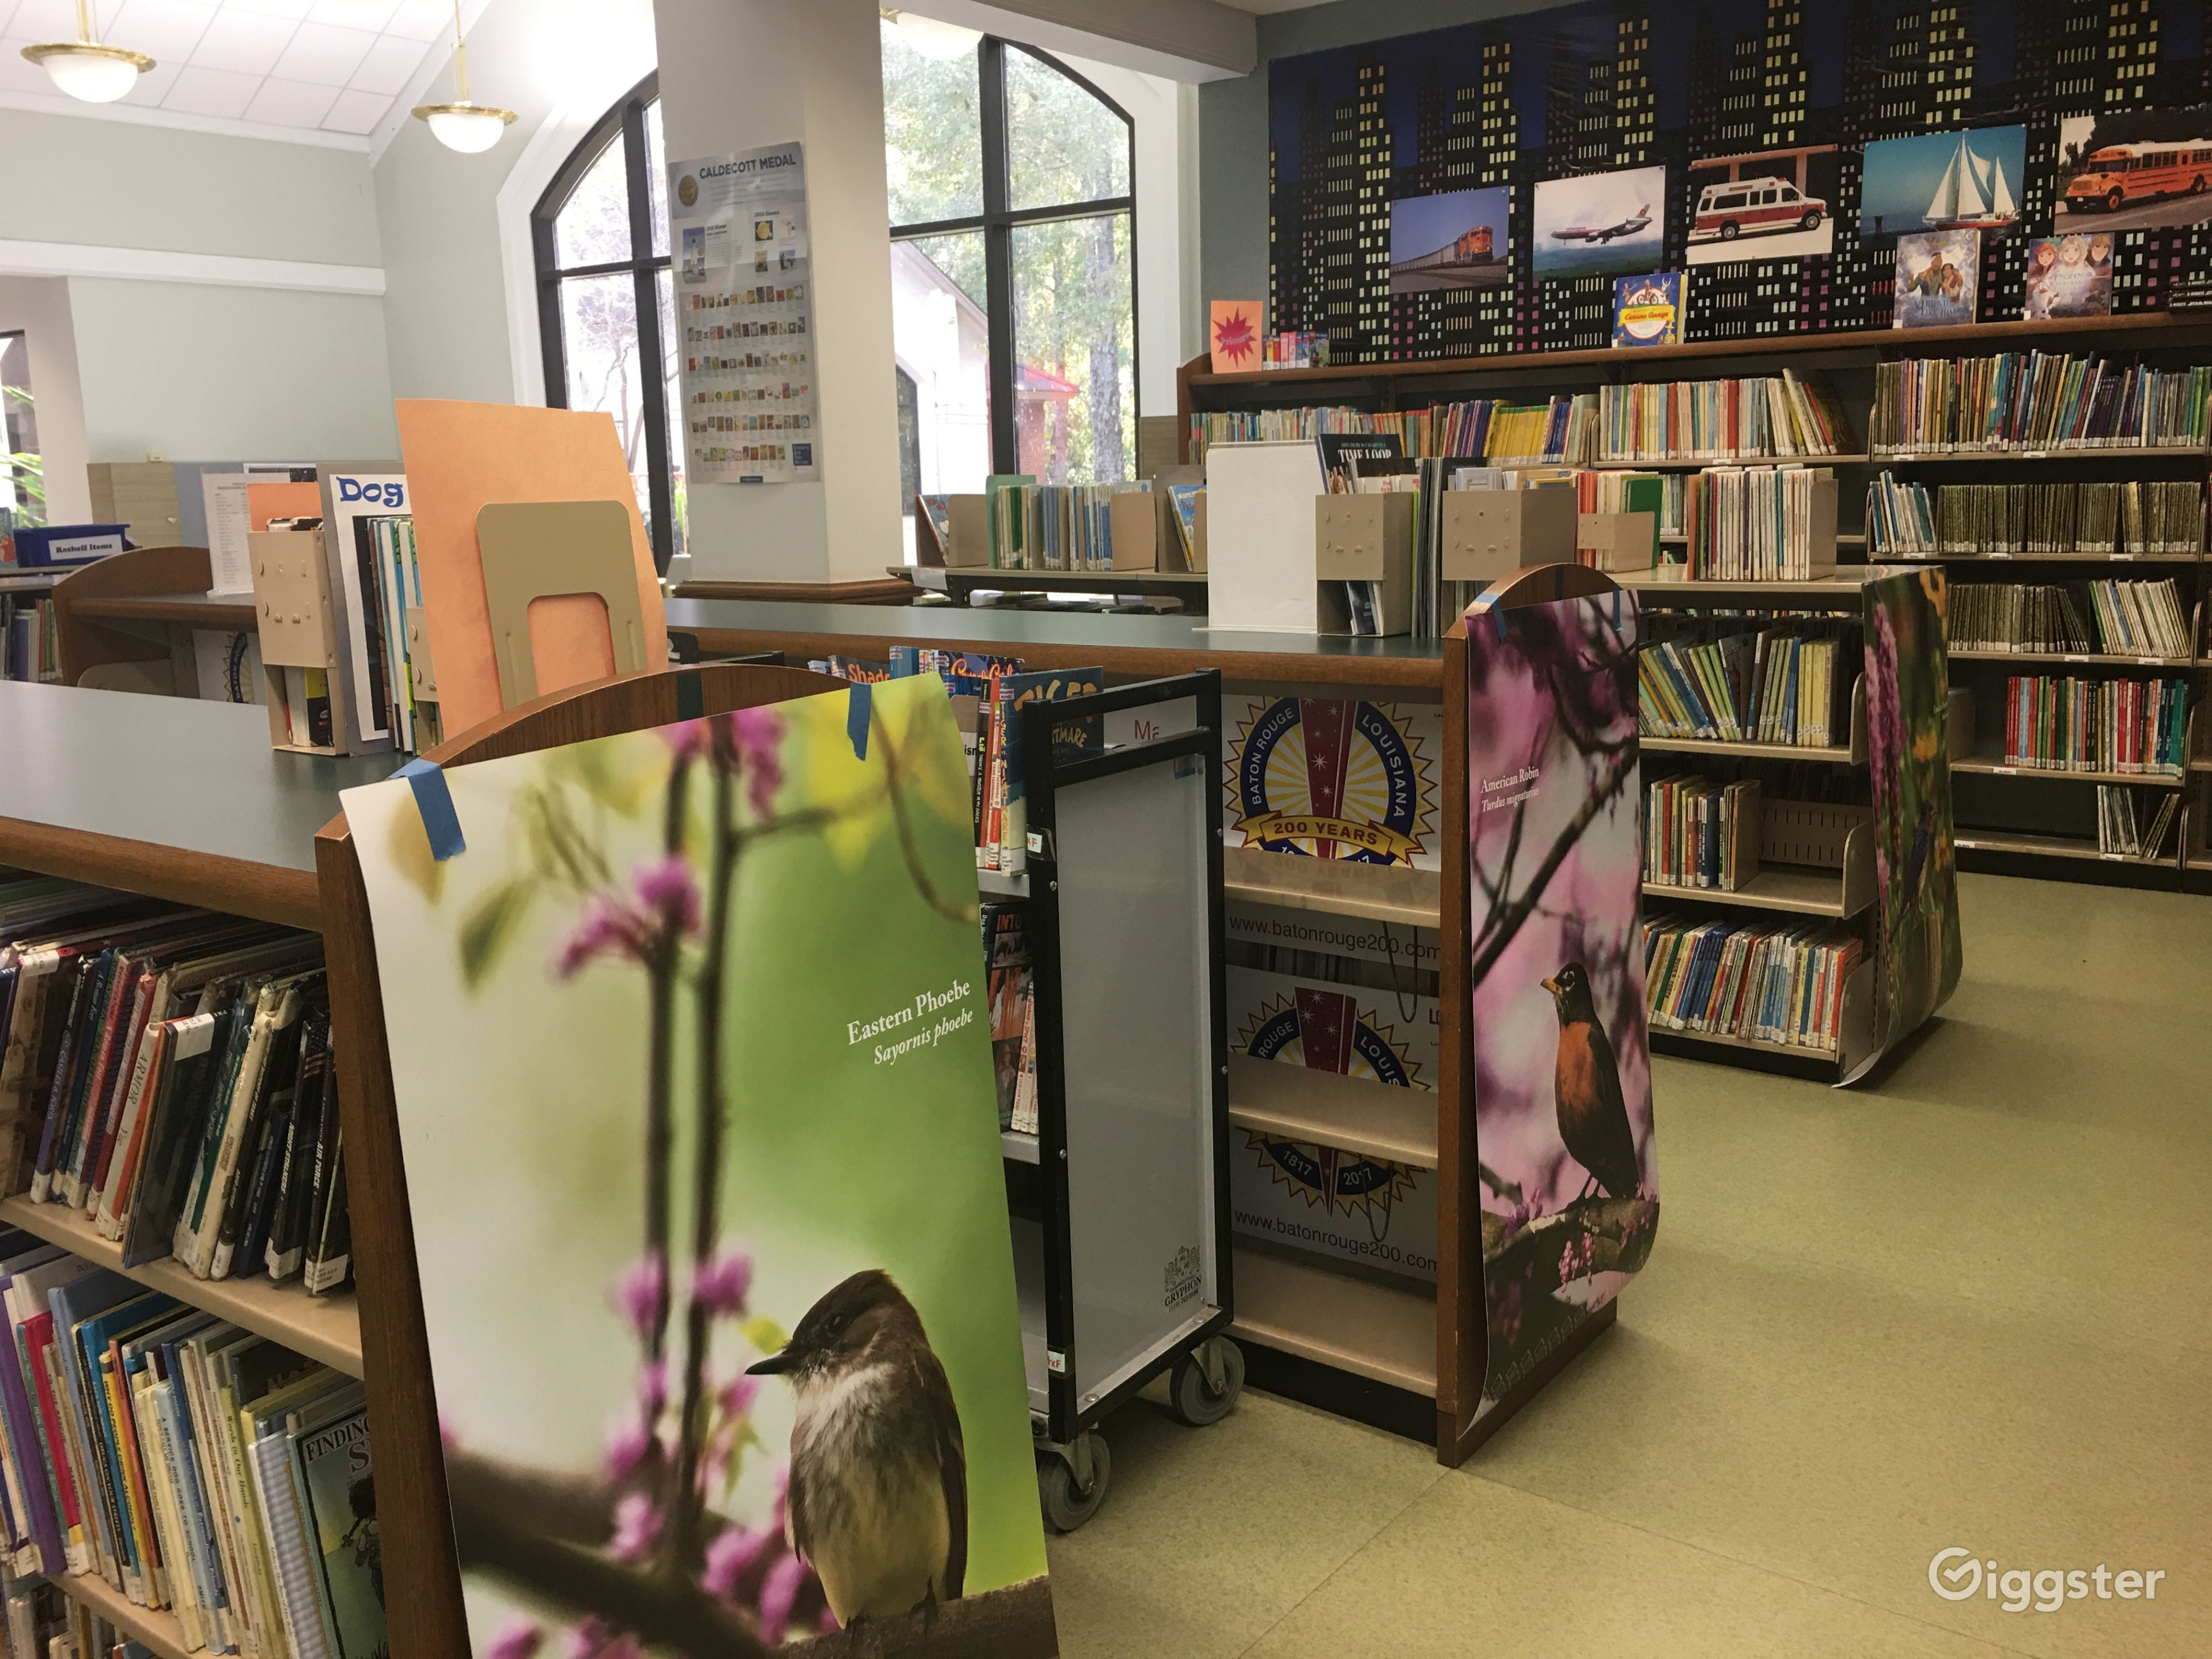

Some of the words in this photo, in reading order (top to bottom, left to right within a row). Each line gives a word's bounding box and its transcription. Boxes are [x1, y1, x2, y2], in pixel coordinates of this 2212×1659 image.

[699, 160, 756, 179] CALDECOTT
[759, 154, 796, 169] MEDAL
[1248, 752, 1262, 805] BATON
[1256, 707, 1295, 749] ROUGE
[1361, 713, 1407, 817] LOUISIANA
[1480, 775, 1518, 794] American
[1519, 766, 1539, 783] Robin
[1481, 796, 1505, 812] Turdus
[1506, 786, 1539, 808] migratorius
[1273, 821, 1308, 835] 200
[1314, 821, 1378, 845] YEARS
[1229, 916, 1440, 960] www.batonrouge200.com
[1671, 956, 1682, 978] BUCK'S
[90, 979, 104, 1005] Roman
[1664, 980, 1675, 999] TOOTH
[847, 1007, 913, 1046] Eastern
[915, 979, 971, 1017] Phoebe
[97, 1032, 112, 1060] Roman
[874, 1028, 931, 1066] Sayornis
[932, 1007, 973, 1047] phoebe
[1258, 1021, 1294, 1058] ROUGE
[52, 1050, 68, 1085] CASTLES
[126, 1048, 150, 1105] ARMOR
[284, 1122, 298, 1151] NIGHT
[315, 1141, 324, 1160] AIR
[276, 1149, 293, 1194] STALKERS
[312, 1159, 322, 1188] FORCE
[1283, 1150, 1312, 1176] 1817
[1343, 1168, 1373, 1186] 2017
[1164, 1274, 1202, 1307] GRYPHON
[102, 1380, 111, 1401] WHY
[107, 1403, 115, 1417] DO
[110, 1418, 122, 1452] PEOPLE
[161, 1426, 176, 1463] SERVICE
[117, 1453, 128, 1483] DRINK
[170, 1465, 181, 1484] DOG
[225, 1415, 237, 1443] Words
[231, 1445, 240, 1455] in
[238, 1479, 251, 1509] Hands
[175, 1487, 187, 1510] GOES
[181, 1514, 191, 1525] TO
[185, 1528, 199, 1562] SCHOOL
[274, 1572, 282, 1584] The
